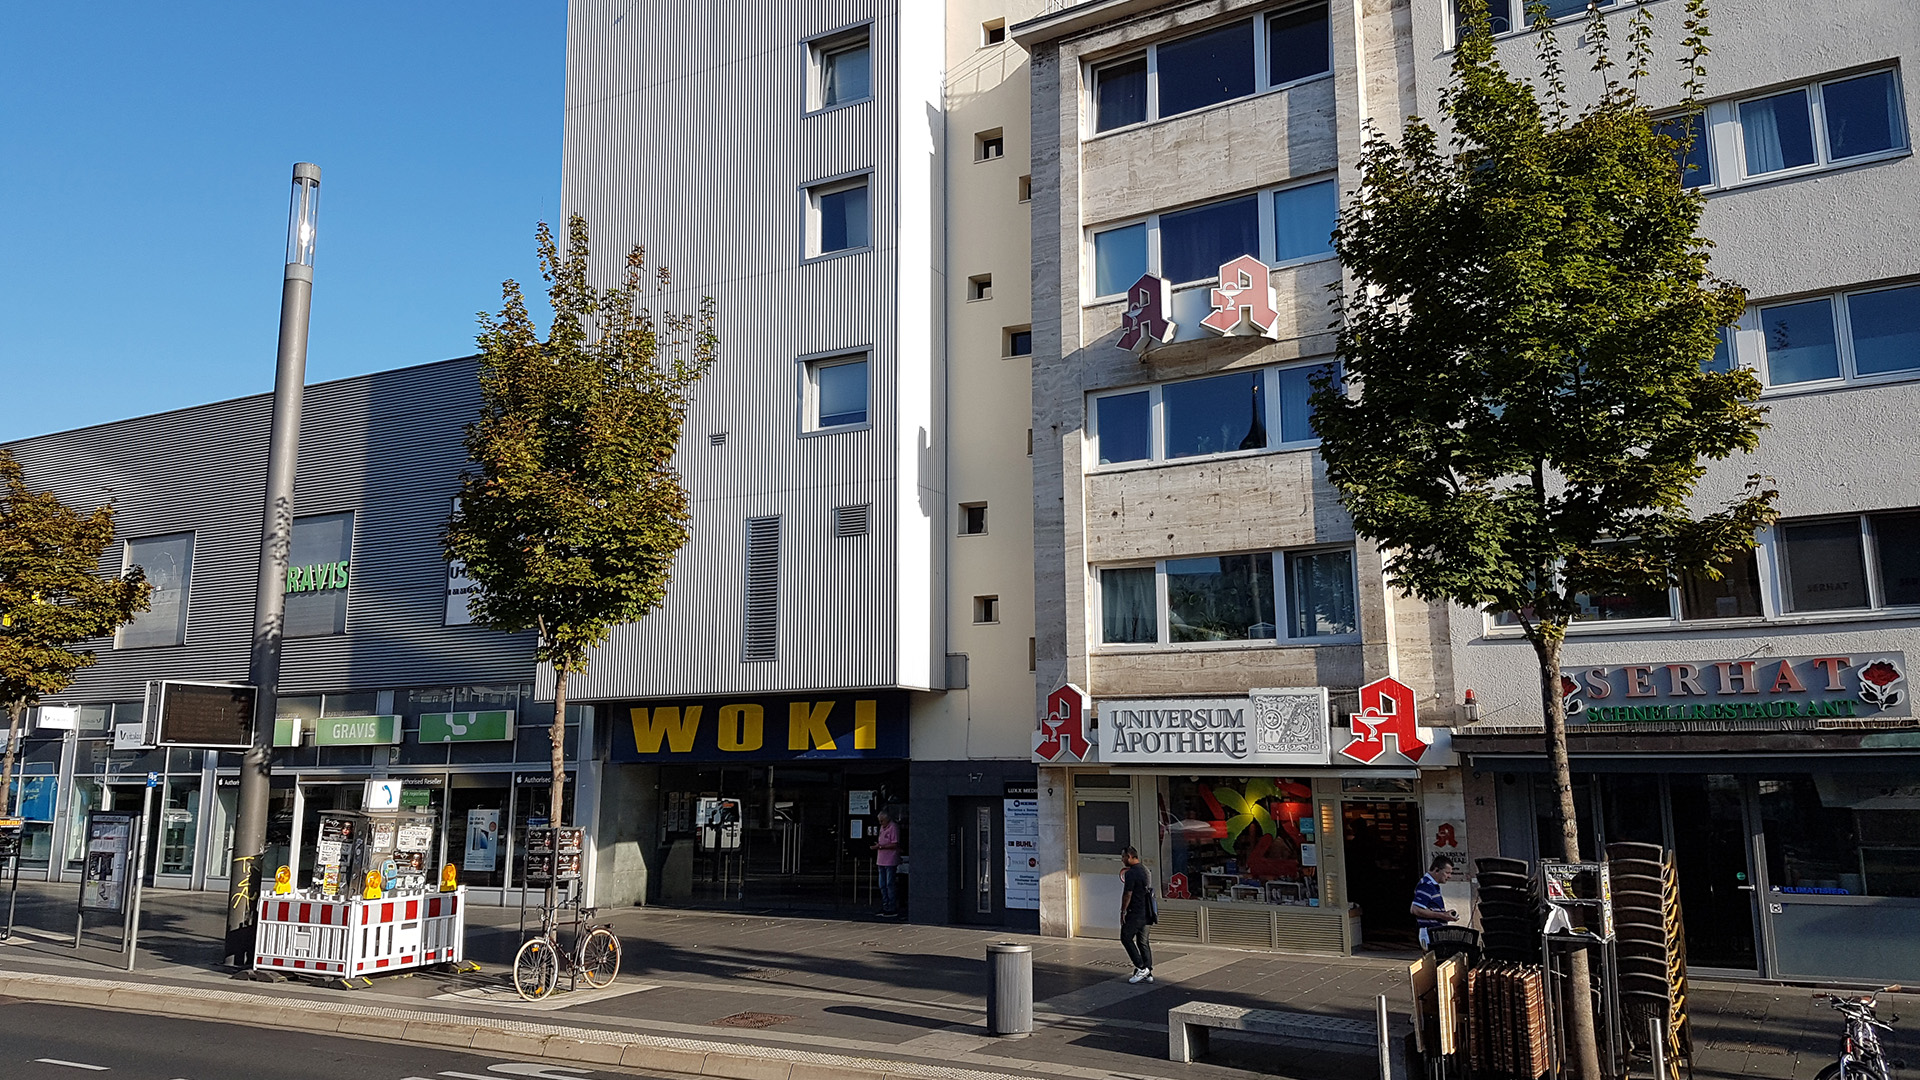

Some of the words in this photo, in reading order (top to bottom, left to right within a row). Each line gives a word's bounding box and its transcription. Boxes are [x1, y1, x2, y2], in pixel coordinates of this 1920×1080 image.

[286, 560, 349, 594] RAVIS
[1585, 656, 1852, 699] SERHAT
[1110, 708, 1246, 731] UNIVERSUM
[1586, 699, 1859, 723] SCHNELLRESTAURANT
[333, 722, 376, 739] GRAVIS
[630, 700, 877, 753] WOKI
[1110, 723, 1248, 759] APOTHEKE
[402, 777, 424, 785] uthorised
[1047, 788, 1053, 797] 9
